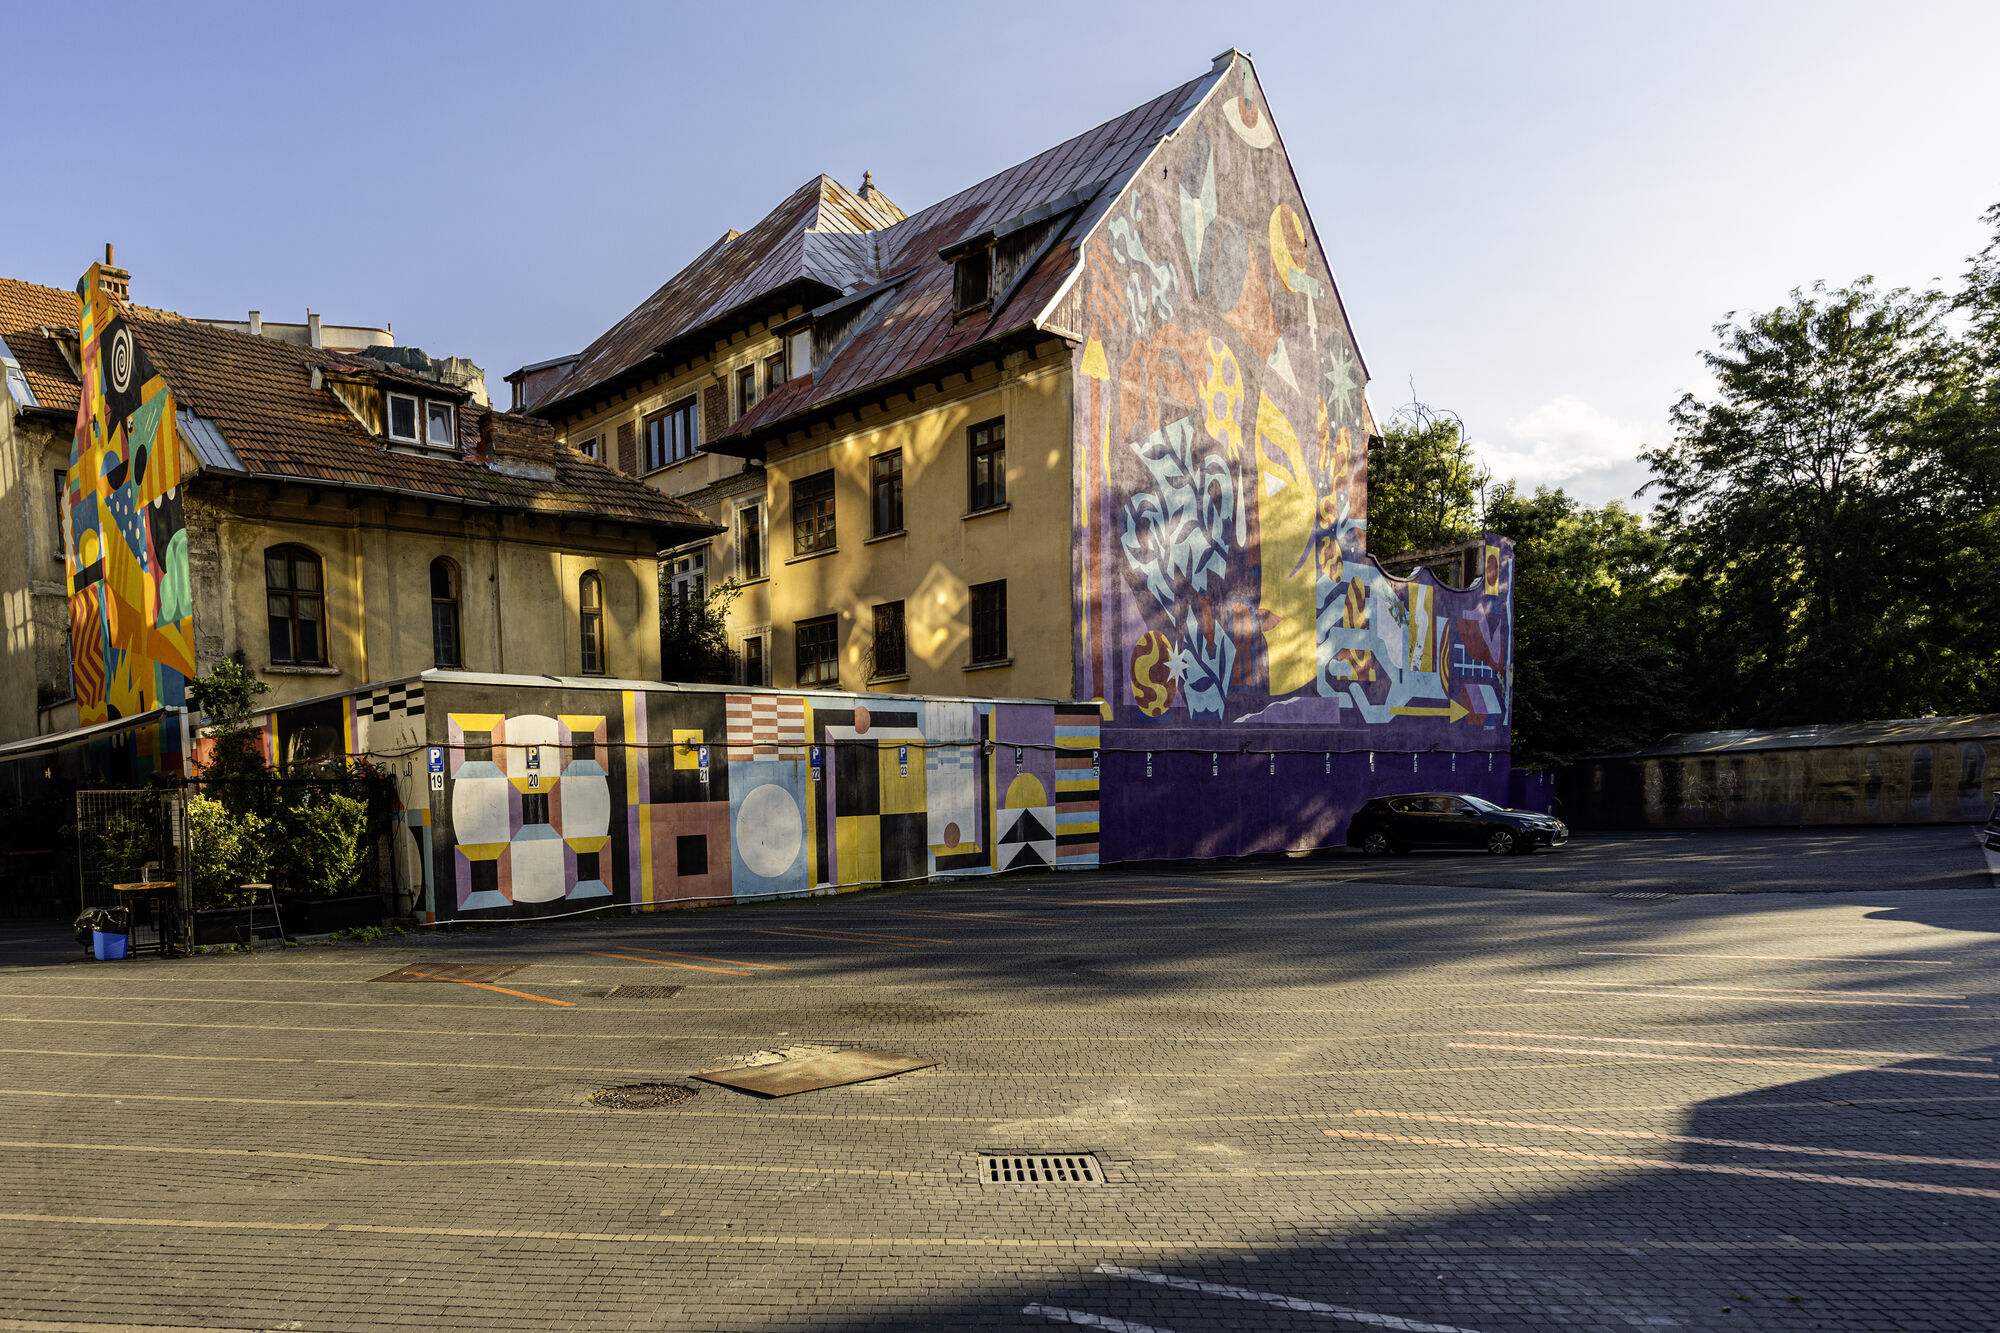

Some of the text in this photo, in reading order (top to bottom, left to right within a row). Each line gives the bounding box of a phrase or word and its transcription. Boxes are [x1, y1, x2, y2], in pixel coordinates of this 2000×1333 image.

[430, 749, 440, 764] P
[528, 747, 537, 761] P
[699, 747, 707, 760] P
[812, 747, 819, 760] P
[900, 747, 906, 758] P
[1016, 747, 1022, 758] P
[1093, 751, 1099, 761] P
[700, 769, 708, 782] 21
[812, 768, 820, 780] 22
[900, 766, 907, 776] 23
[431, 774, 443, 789] 19
[528, 773, 539, 787] 20
